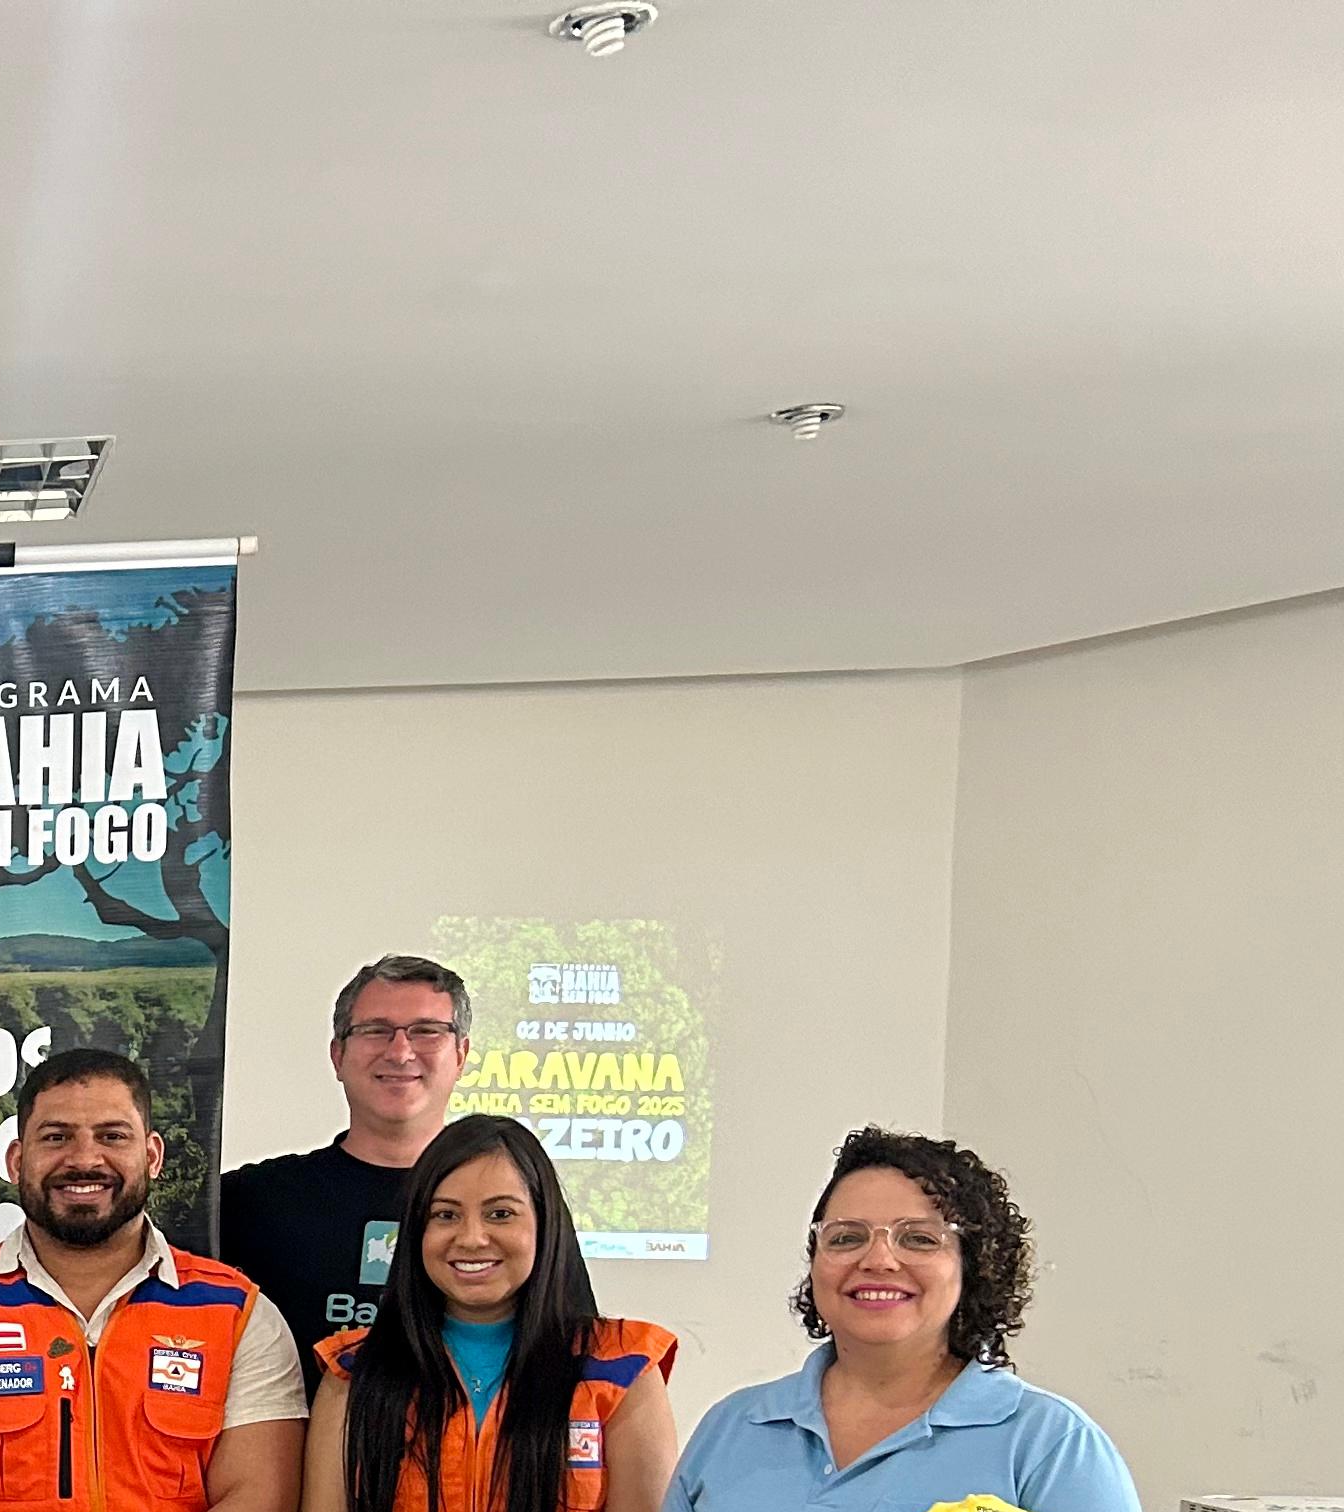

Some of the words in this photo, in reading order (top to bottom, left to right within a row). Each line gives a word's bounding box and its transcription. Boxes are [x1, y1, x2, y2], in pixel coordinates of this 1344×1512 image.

[27, 802, 168, 868] FOGO
[516, 1021, 541, 1041] 02
[544, 1021, 569, 1041] DE
[572, 1021, 635, 1042] JUNHO
[455, 1050, 684, 1092] CARAVANA
[449, 1092, 522, 1114] BAHIA
[529, 1094, 572, 1115] SEM
[576, 1095, 632, 1116] FOGO
[637, 1095, 685, 1117] 2025
[534, 1117, 685, 1162] ZEIRO
[325, 1293, 379, 1325] Ba
